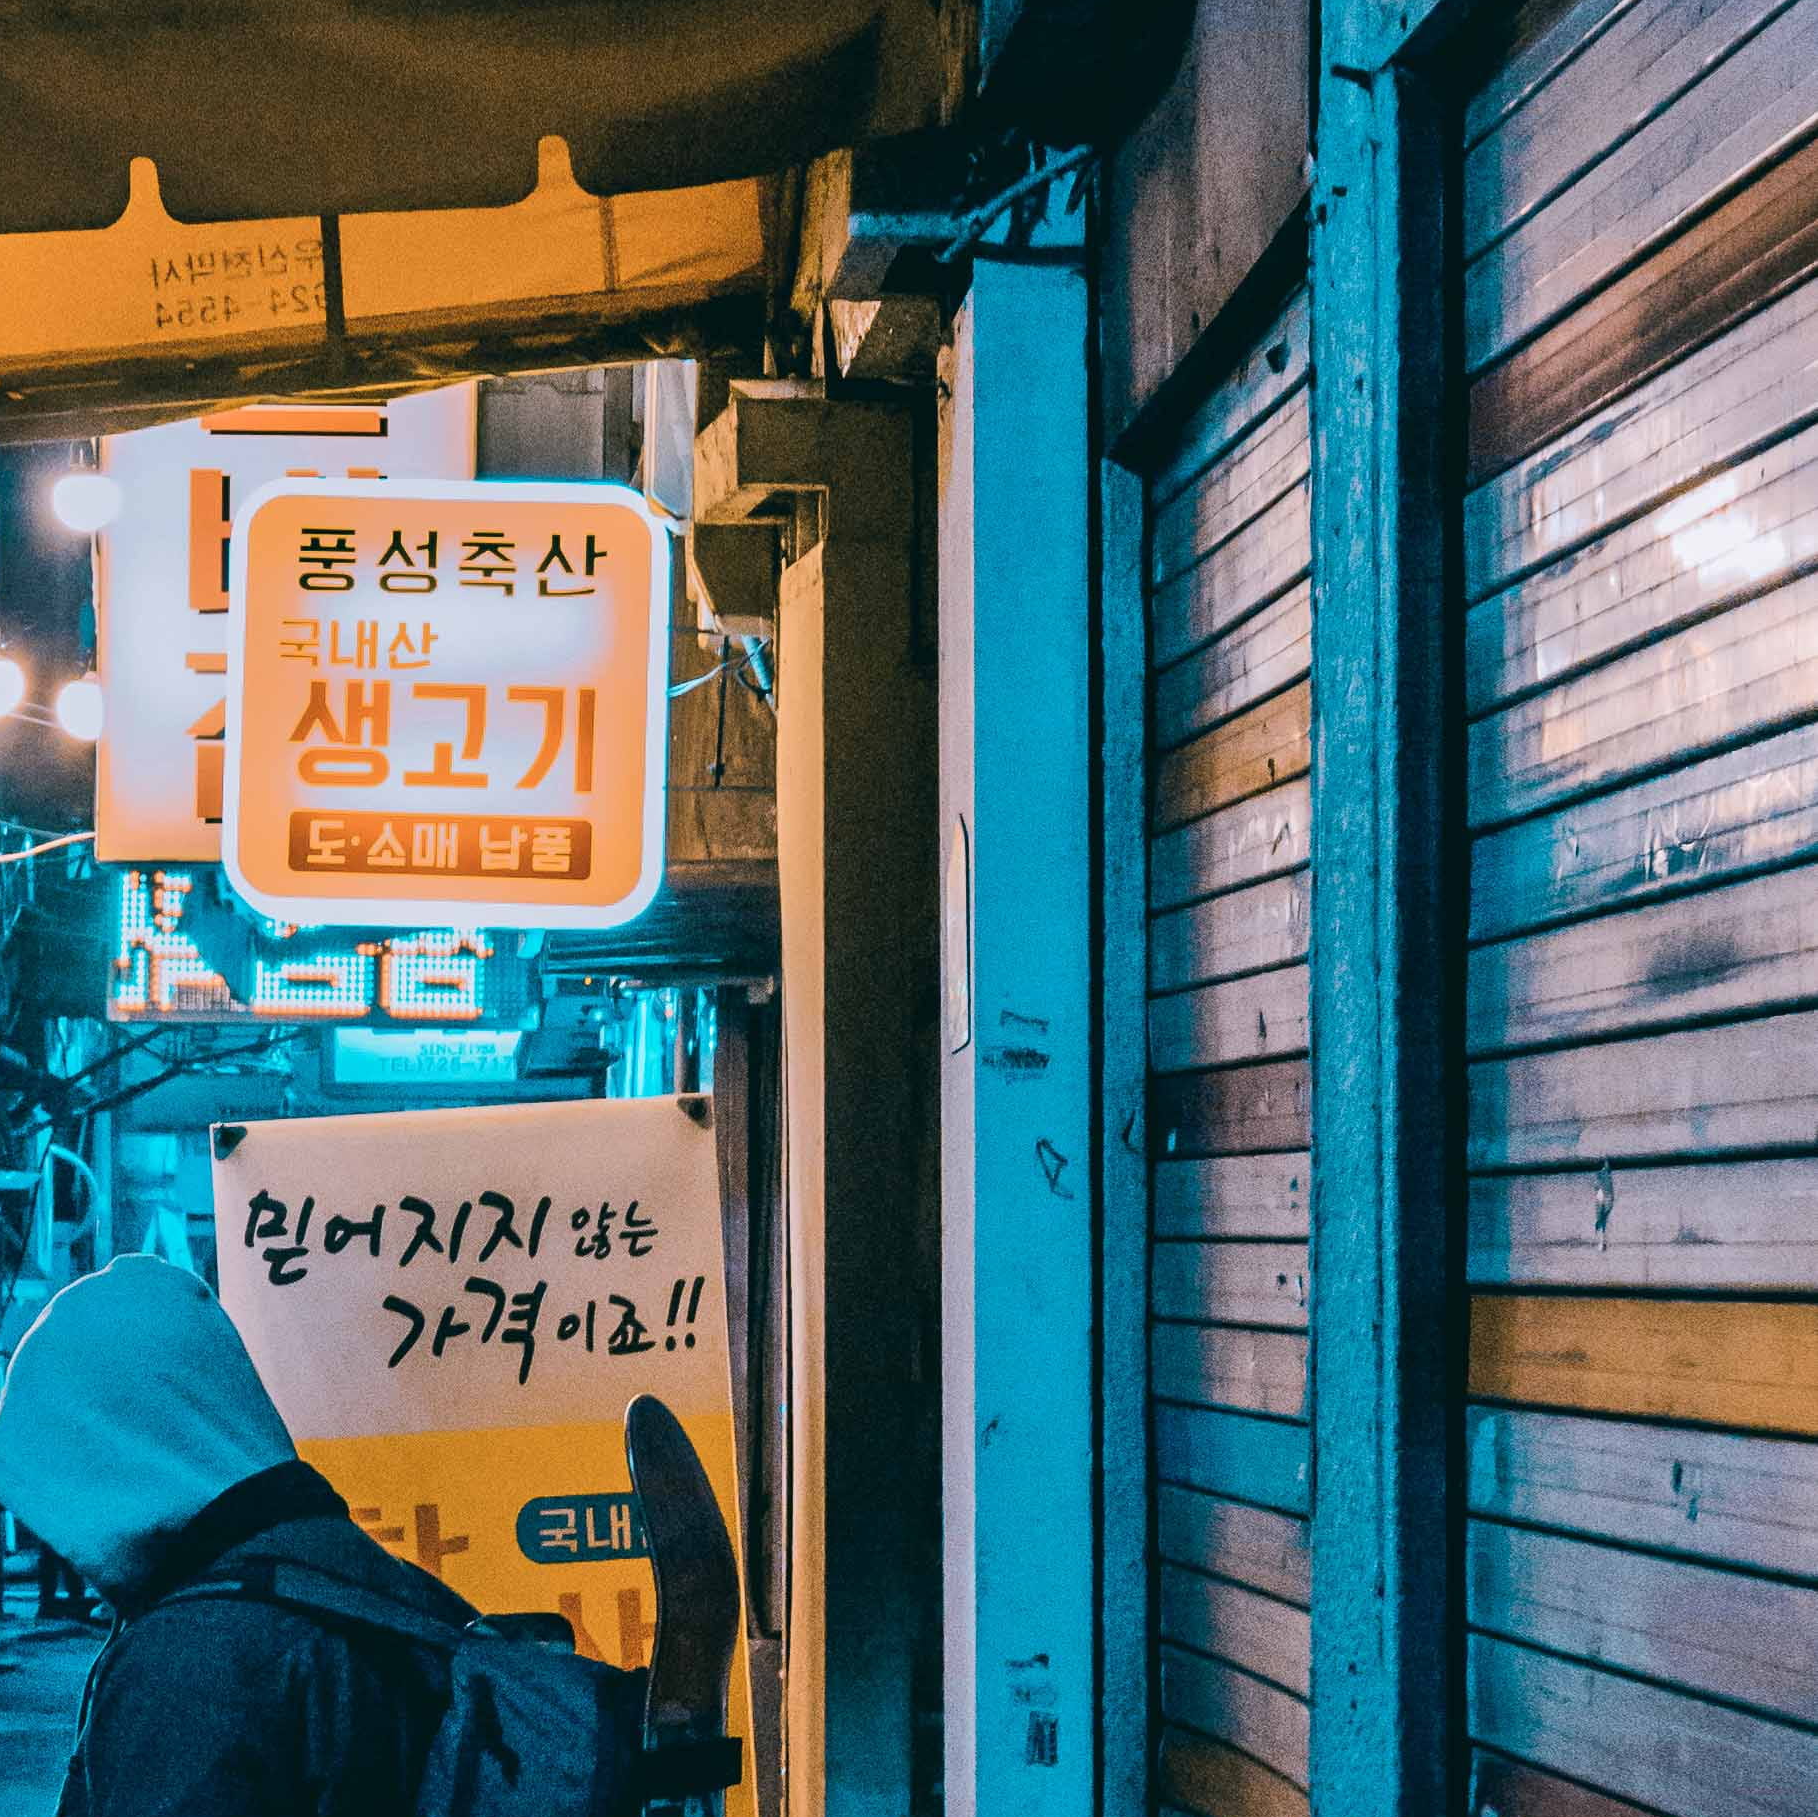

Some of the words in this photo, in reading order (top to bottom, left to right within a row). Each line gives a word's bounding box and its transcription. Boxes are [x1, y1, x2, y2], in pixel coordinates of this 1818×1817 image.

[297, 527, 608, 597] 풍성축산
[279, 617, 440, 669] 국내산
[289, 679, 597, 795] 생고기
[479, 823, 572, 873] 납품
[244, 1189, 552, 1287] 믿어지지
[571, 1199, 660, 1261] 않는
[381, 1276, 706, 1385] 가격이죠!!
[538, 1503, 647, 1554] 국내
